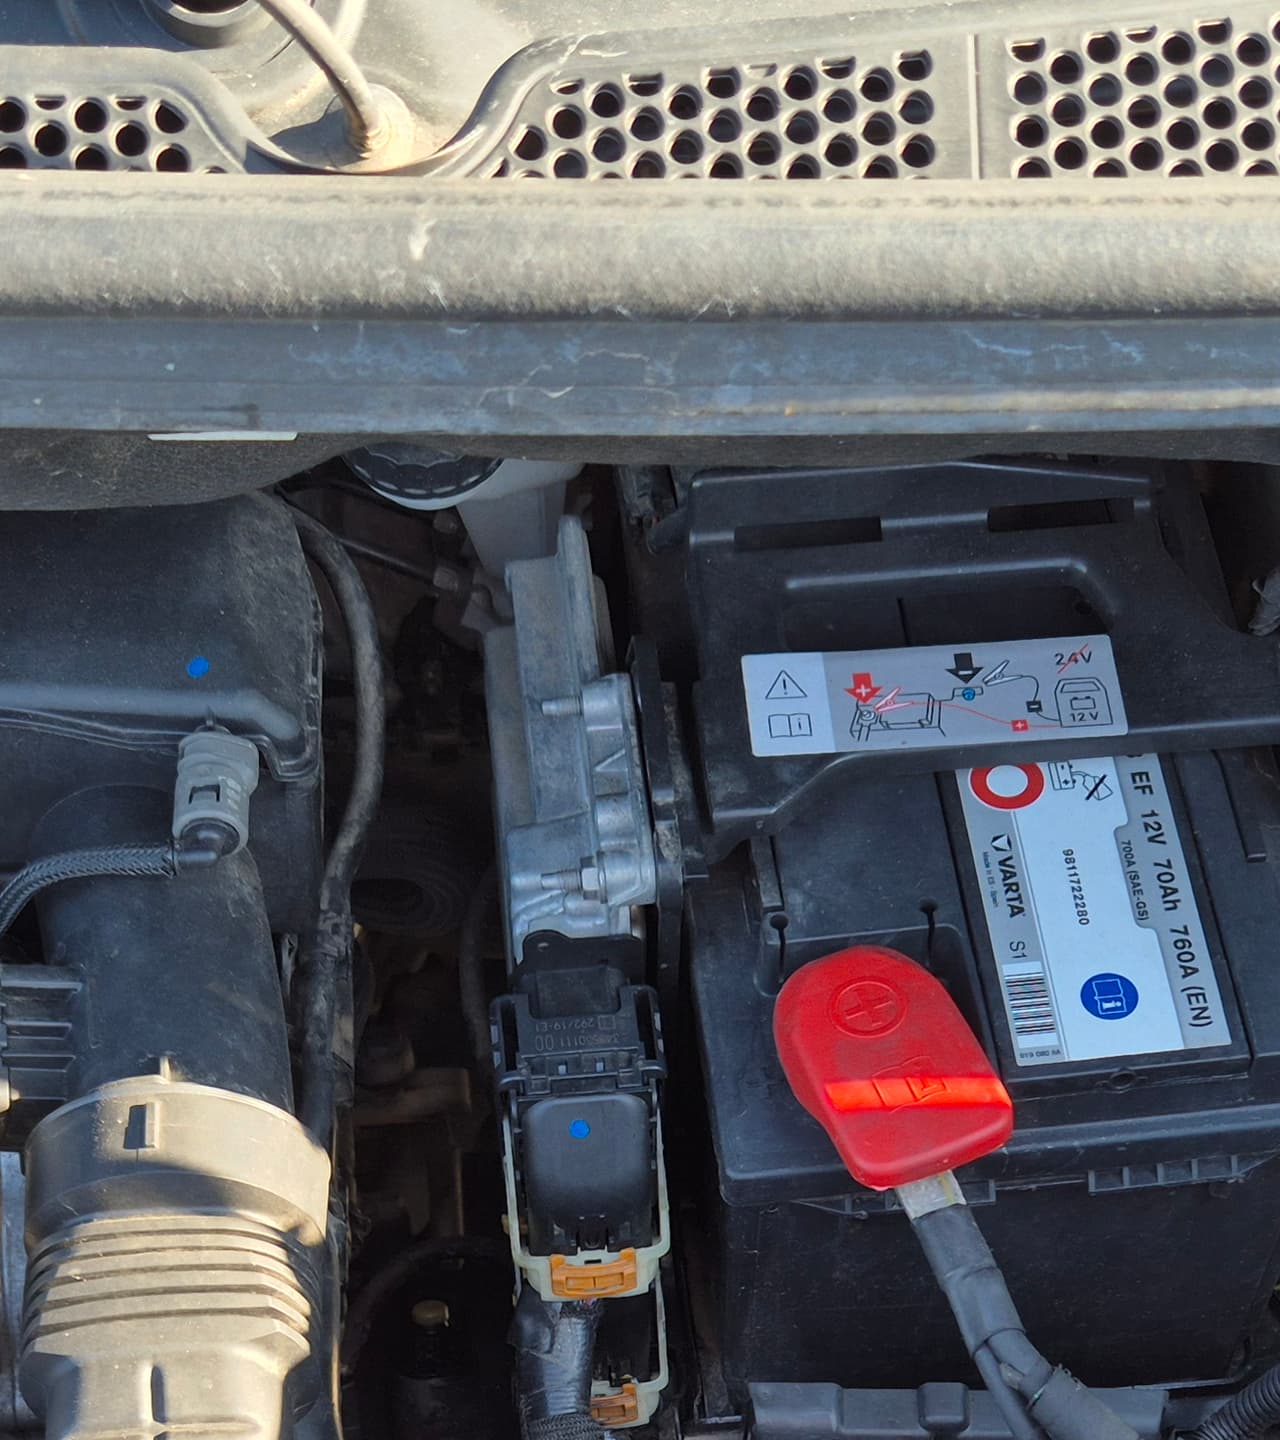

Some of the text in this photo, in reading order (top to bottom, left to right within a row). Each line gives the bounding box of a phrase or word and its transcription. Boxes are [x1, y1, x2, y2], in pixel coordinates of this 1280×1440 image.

[1054, 650, 1093, 667] 24V
[1070, 712, 1099, 723] 12 V
[1141, 809, 1167, 846] 12V
[996, 855, 1027, 959] VARTA S1
[1062, 848, 1090, 926] 9811722280
[1121, 839, 1149, 921] 700A (SAE-GS)
[1153, 858, 1179, 912] 70Ah
[1170, 925, 1197, 979] 760A
[1180, 985, 1213, 1028] (EN)
